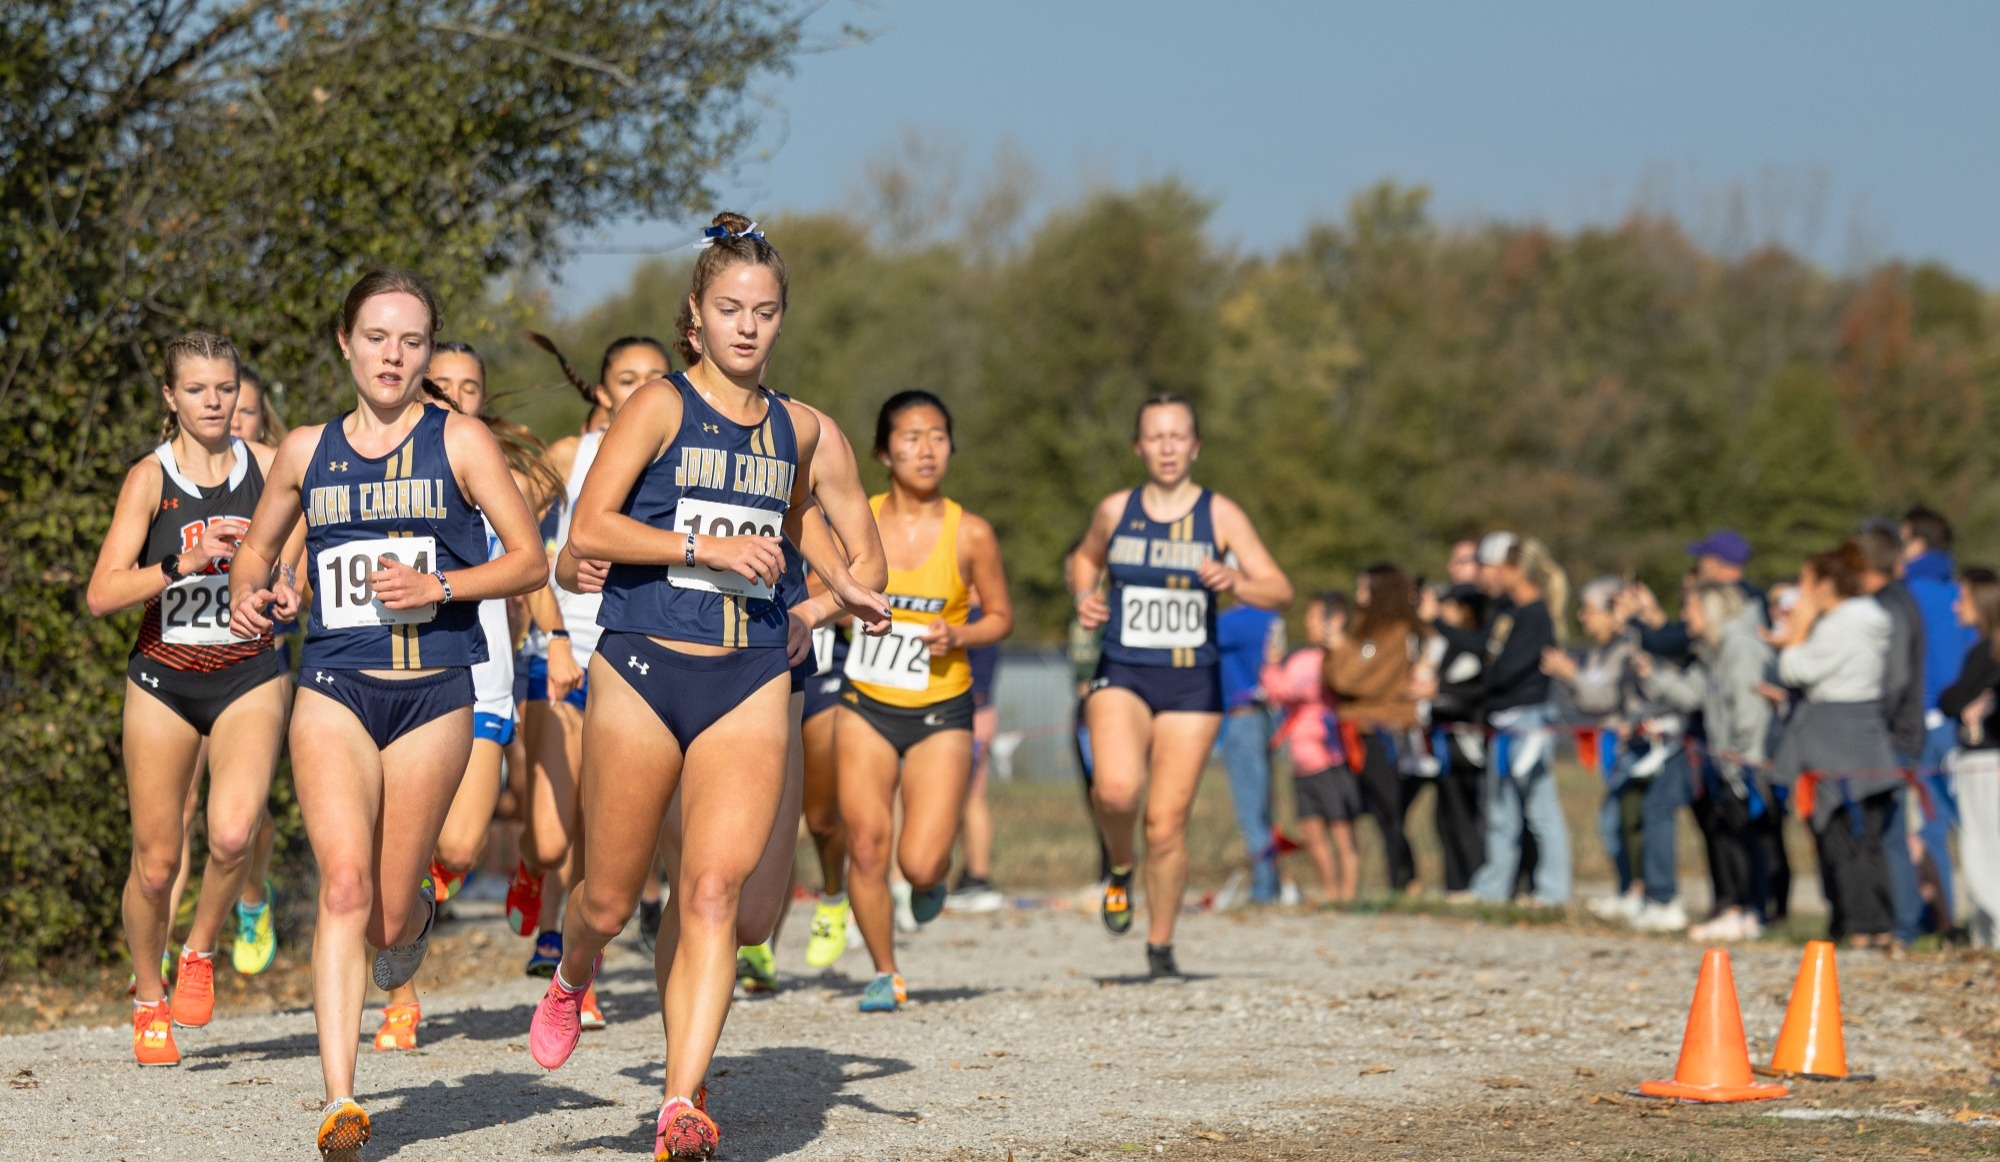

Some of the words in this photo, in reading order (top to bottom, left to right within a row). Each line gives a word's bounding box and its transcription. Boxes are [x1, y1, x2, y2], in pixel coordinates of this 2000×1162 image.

[676, 447, 727, 490] JOHN
[308, 485, 351, 527] JOHN
[359, 479, 447, 520] CARROLL
[1128, 598, 1201, 633] 2000
